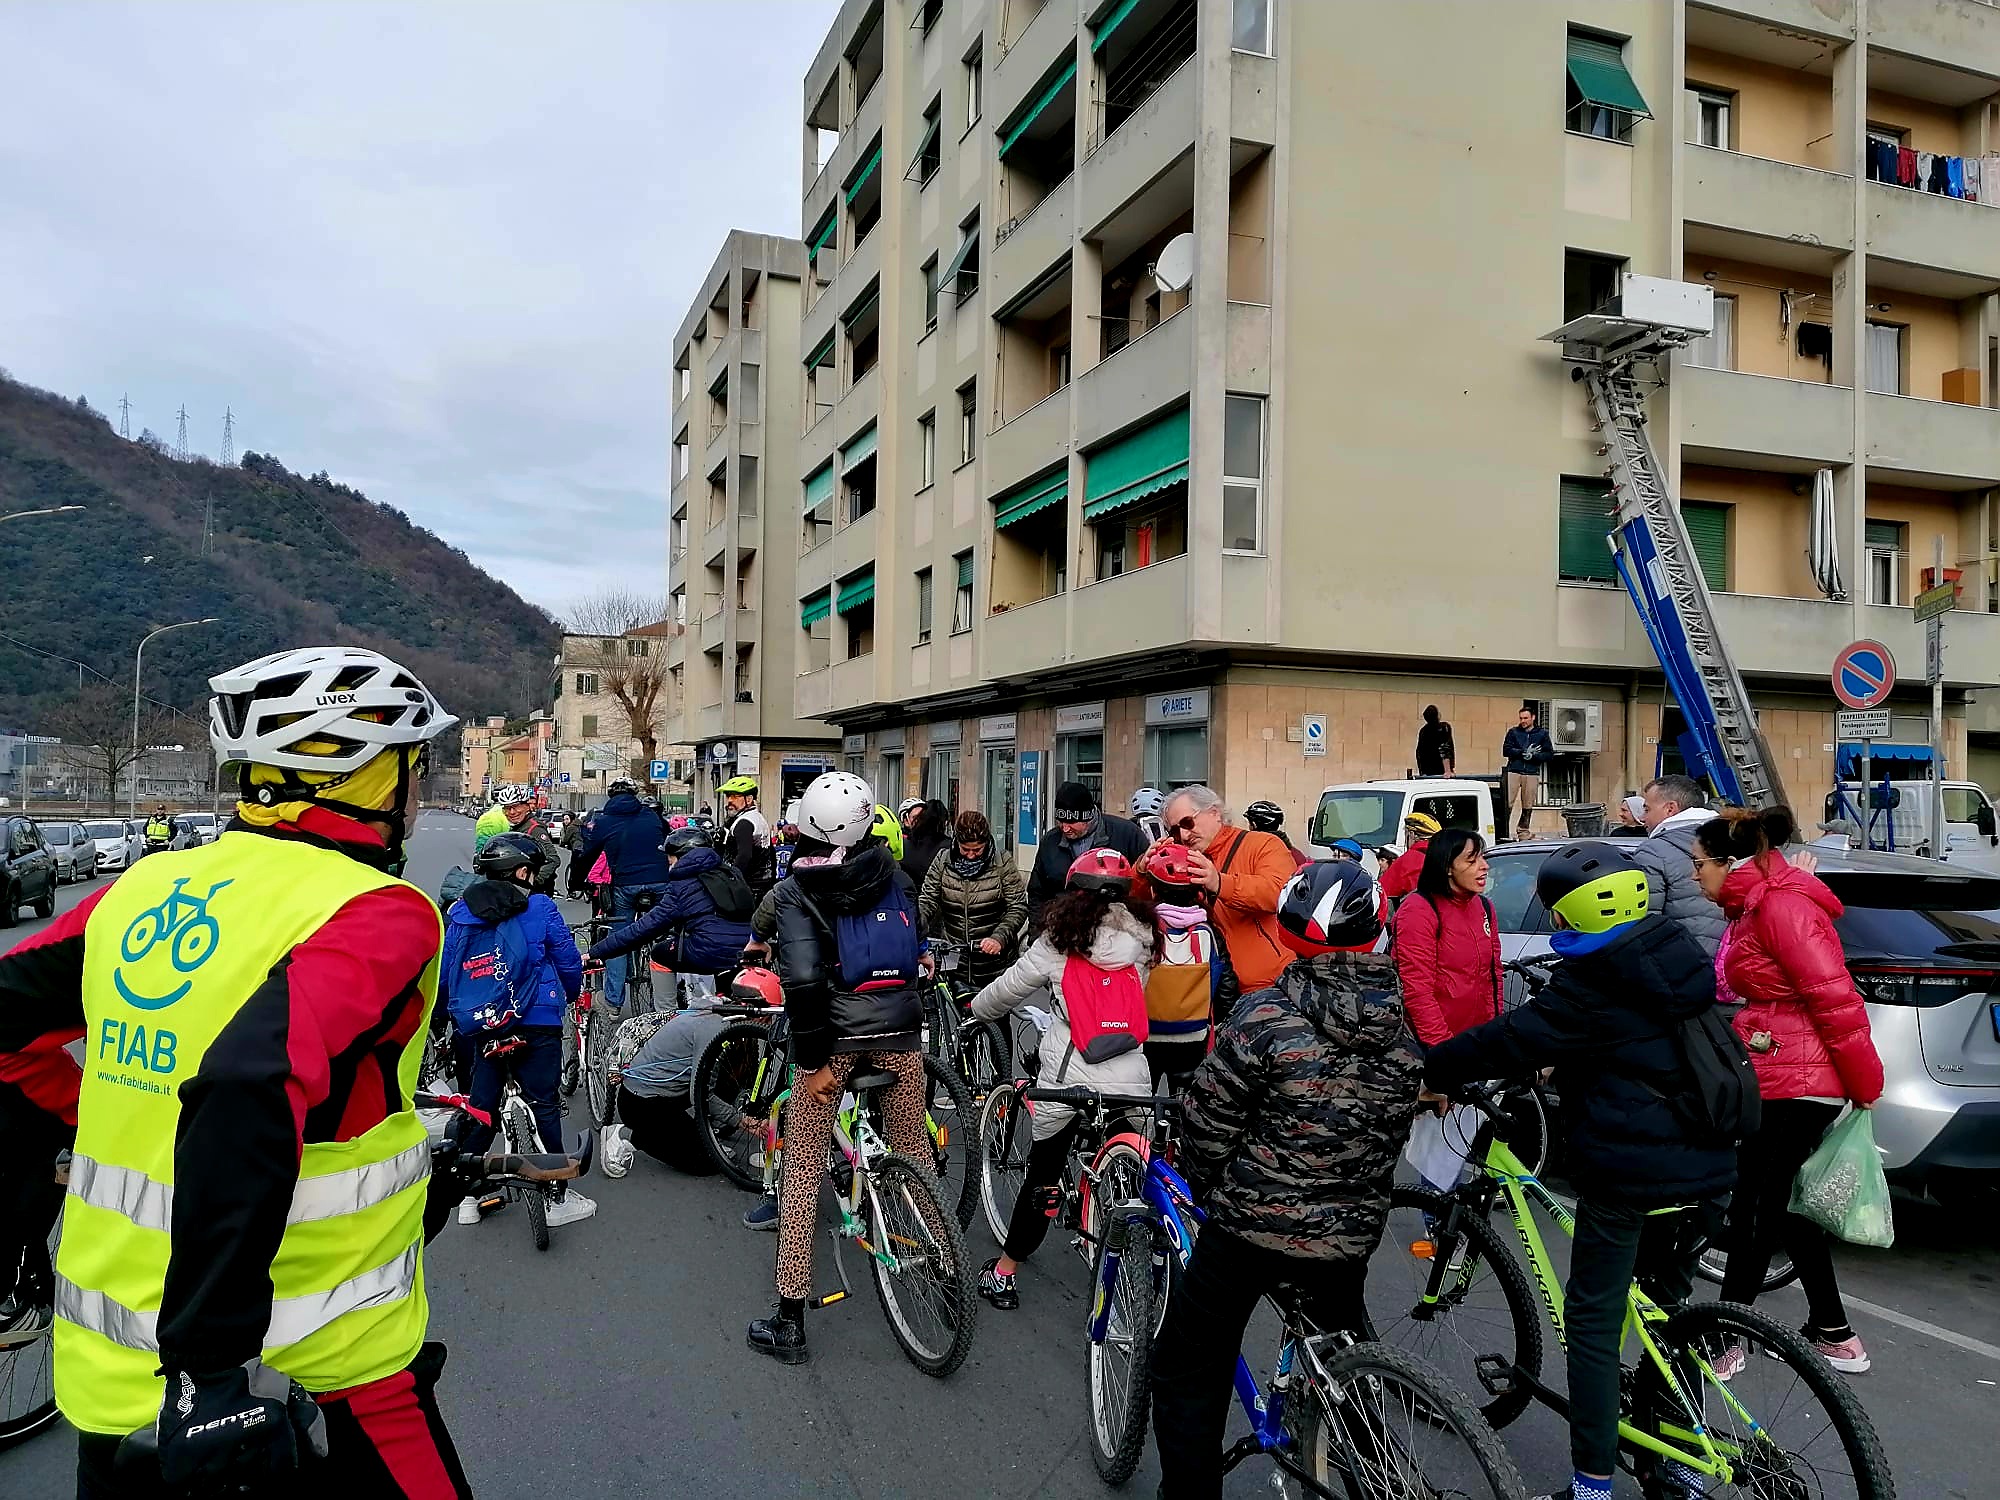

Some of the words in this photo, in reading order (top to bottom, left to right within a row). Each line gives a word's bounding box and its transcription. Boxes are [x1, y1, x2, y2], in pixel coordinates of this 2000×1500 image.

[315, 693, 358, 706] uvex
[1170, 697, 1193, 712] ARIETE
[653, 761, 664, 777] P
[872, 969, 899, 977] GIVOVA
[100, 1018, 177, 1074] FIAB
[97, 1070, 171, 1096] www.fiabitalia.it
[185, 1406, 265, 1438] penta
